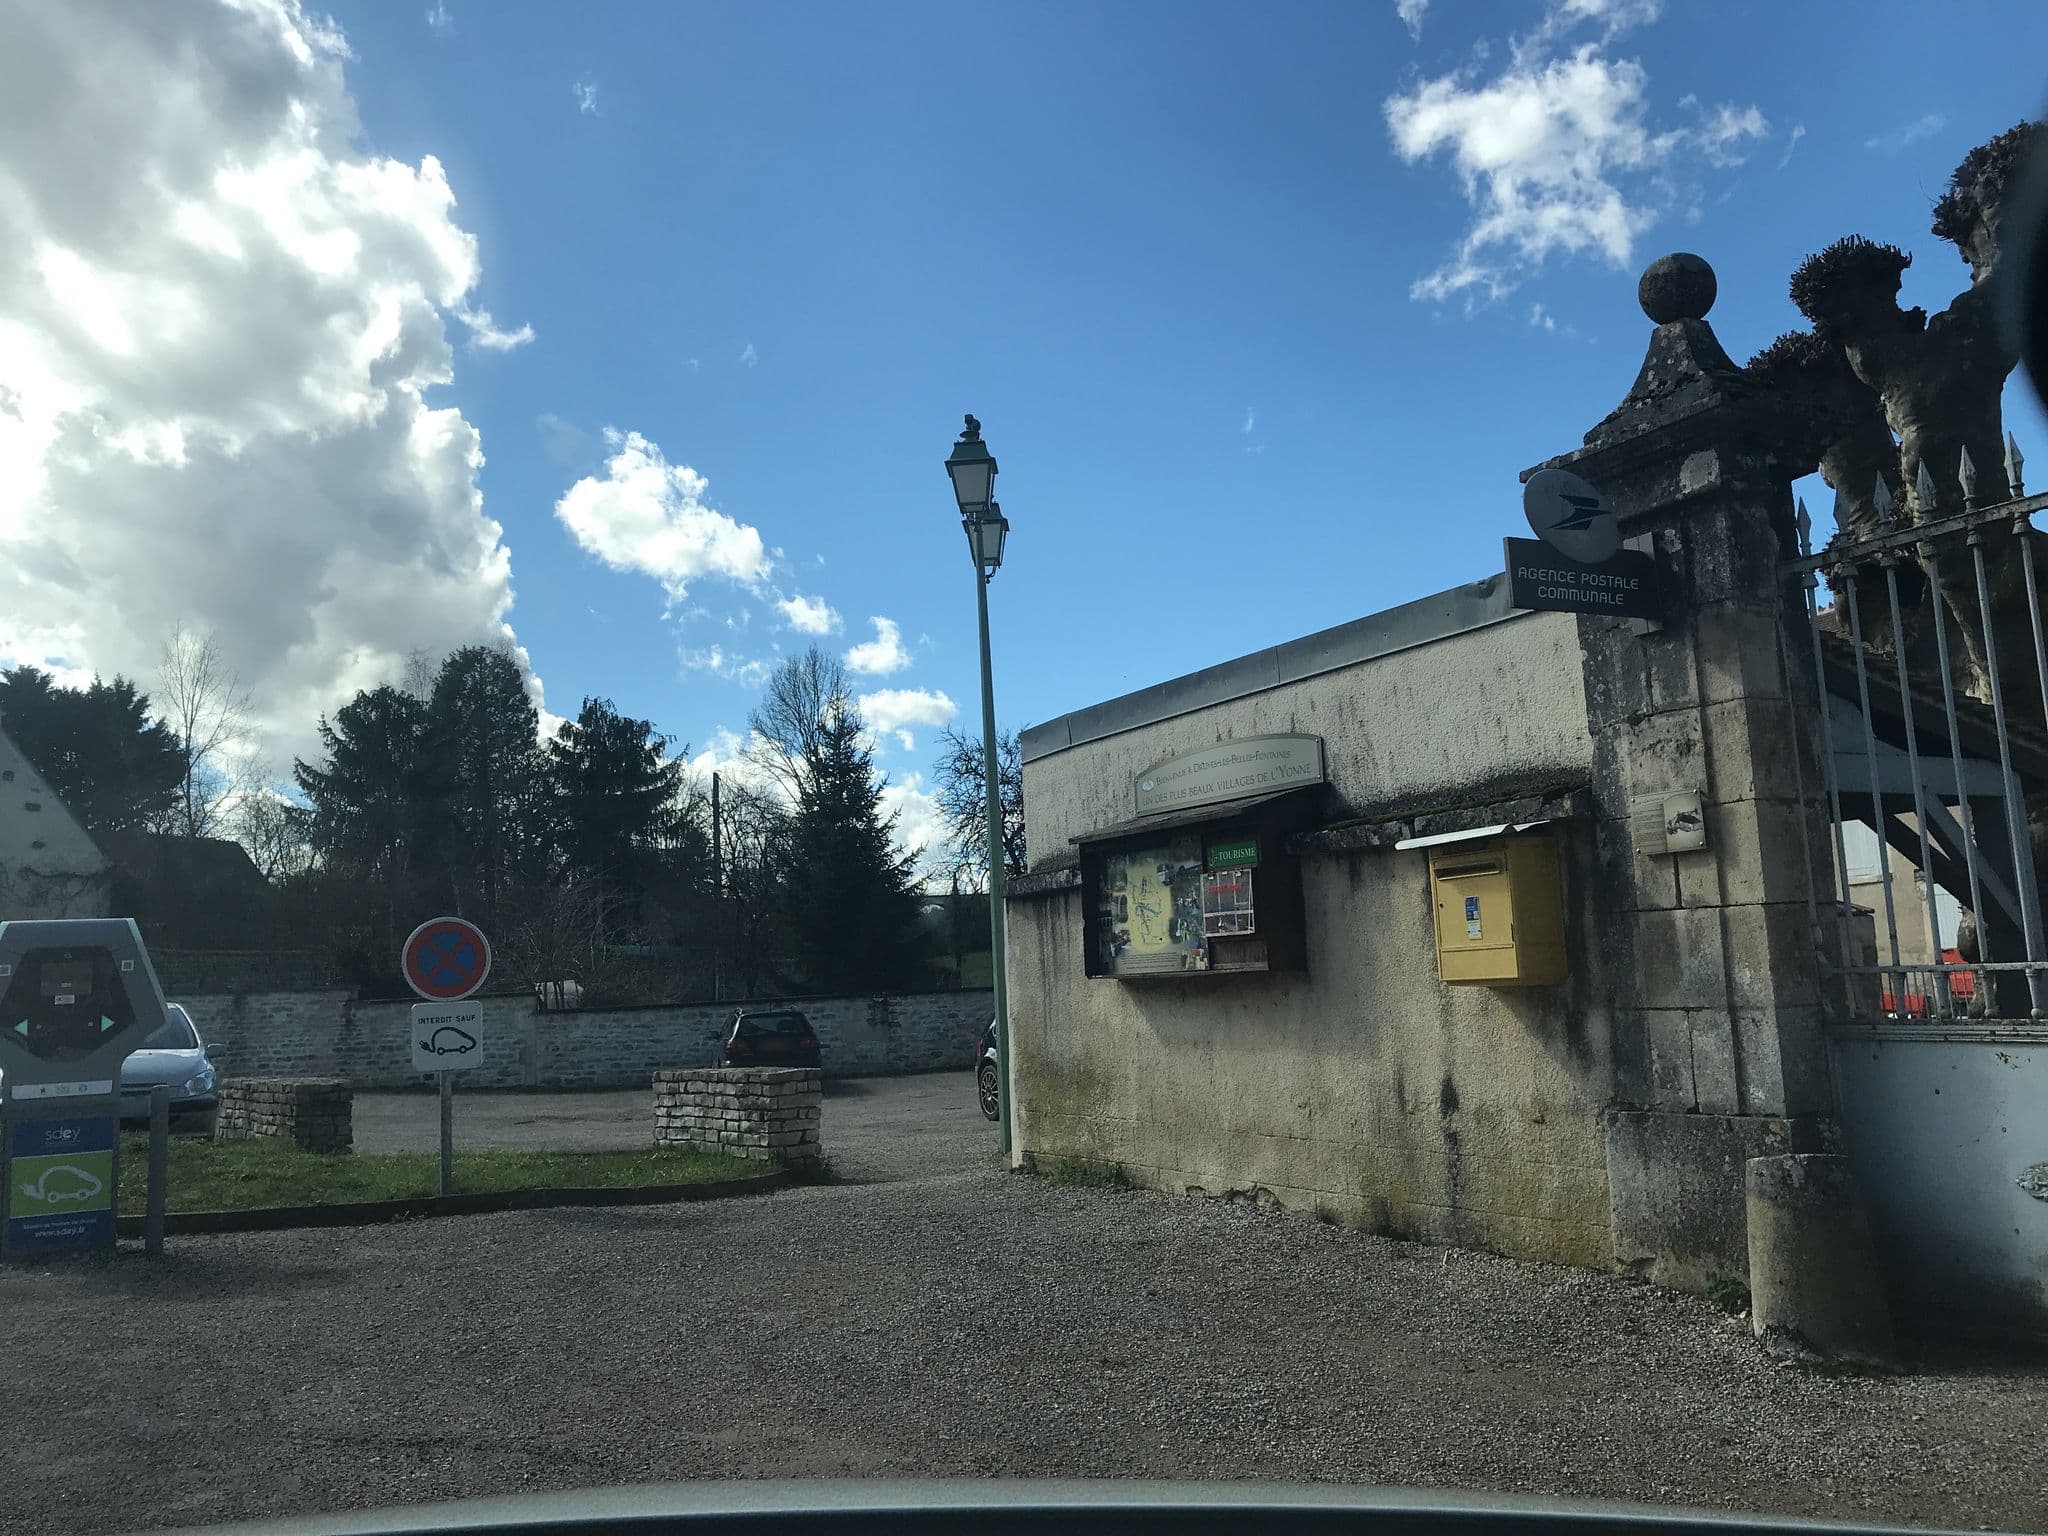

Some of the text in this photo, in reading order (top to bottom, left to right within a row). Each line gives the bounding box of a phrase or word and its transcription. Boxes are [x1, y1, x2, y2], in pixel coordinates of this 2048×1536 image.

[1518, 566, 1639, 590] AGENCE POSTALE
[1537, 586, 1624, 605] COMMUNALE
[1155, 792, 1168, 804] DES
[1169, 789, 1187, 801] PLUS
[1188, 782, 1214, 798] BEAUX
[1216, 773, 1255, 792] VILLAGES
[1257, 771, 1268, 783] DE
[418, 1014, 476, 1025] INTERDIT SAUF
[45, 1126, 80, 1141] sdey
